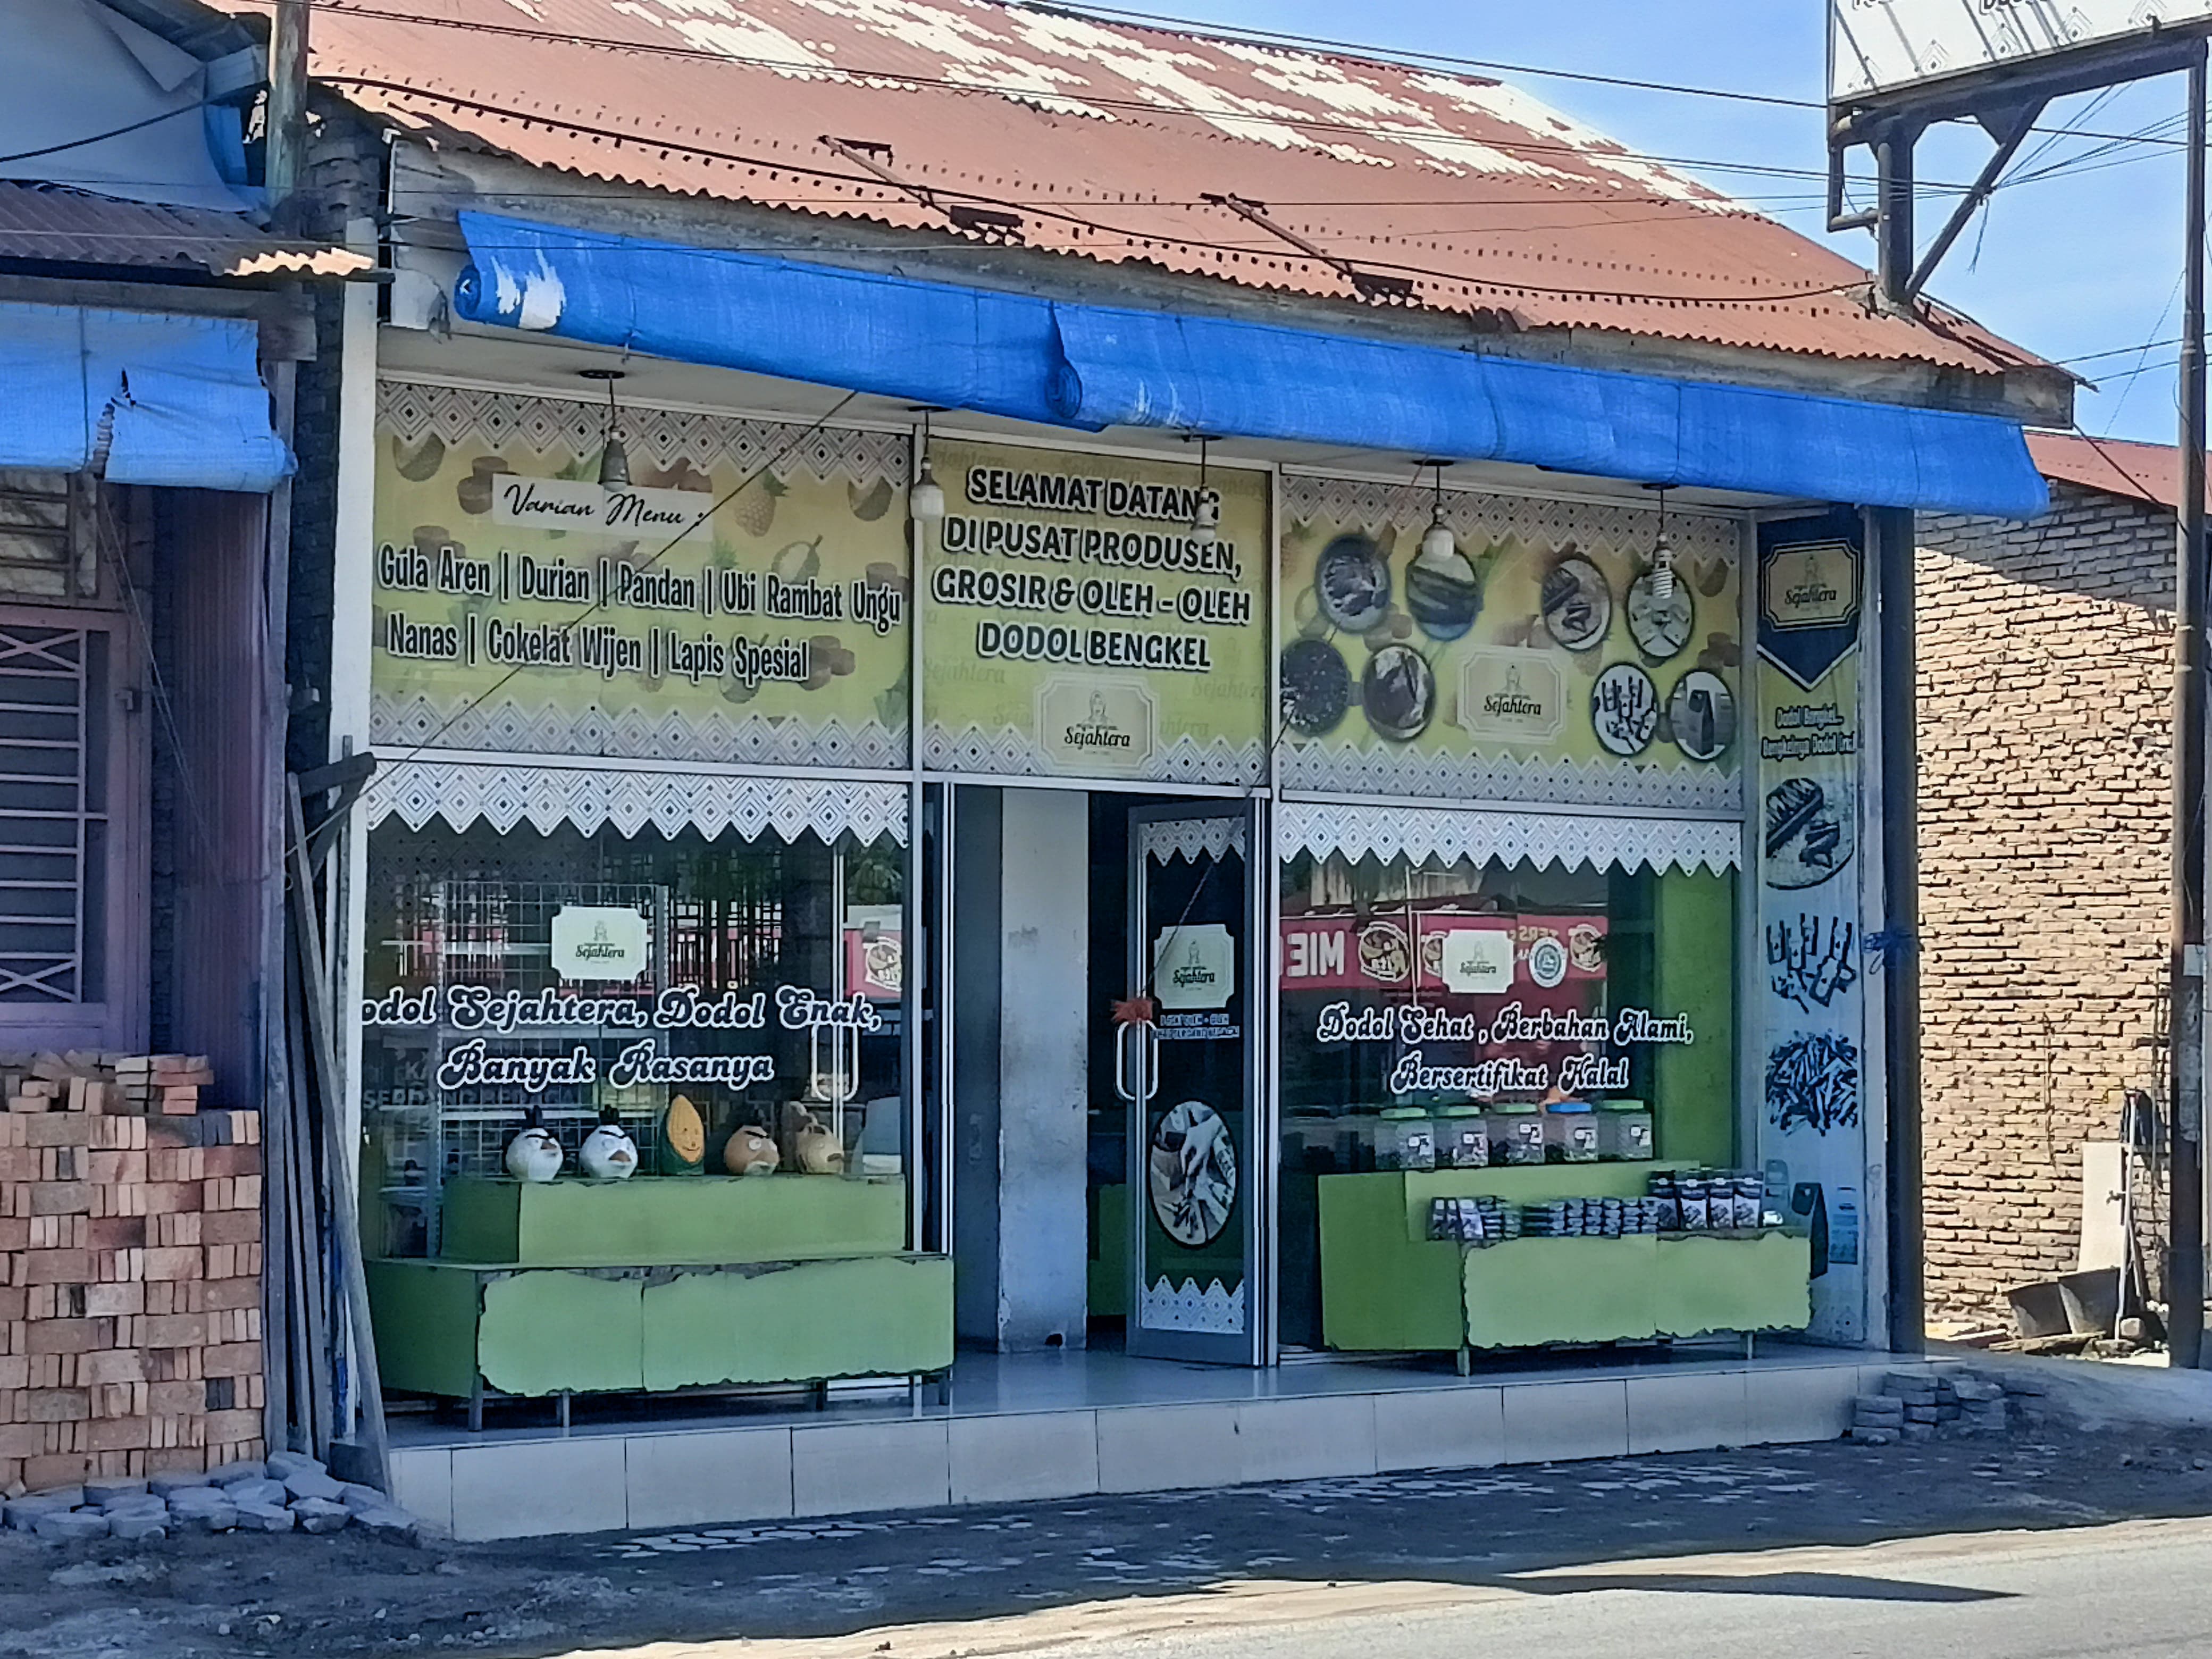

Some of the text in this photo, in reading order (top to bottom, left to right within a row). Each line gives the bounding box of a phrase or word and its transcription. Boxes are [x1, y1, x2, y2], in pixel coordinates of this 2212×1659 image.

[503, 484, 594, 518] Varian
[605, 494, 684, 526] Menu
[969, 466, 1103, 509] SELAMAT
[944, 517, 1242, 581] DI PUSAT PRODUSEN,
[380, 544, 428, 591] Gula
[439, 548, 491, 592] Aren
[521, 560, 590, 602] Durian
[619, 565, 697, 610] Pandan
[720, 569, 757, 615] Ubi
[767, 574, 843, 620] Rambat
[852, 581, 901, 636] Ungu
[934, 567, 1046, 608] GROSIR
[1051, 576, 1075, 607] &
[1080, 579, 1155, 617] OLEH
[1178, 589, 1251, 624] OLEH
[388, 613, 458, 659] Nanas
[487, 622, 572, 668] Cokelat
[581, 624, 643, 677] Wijen
[669, 634, 724, 686] Lapis
[733, 640, 808, 688] Spesial
[979, 622, 1212, 669] DODOL BENGKEL
[1065, 726, 1130, 750] Sejahtera
[362, 984, 882, 1034] odol Sejahtera, Dodol Enak,
[1317, 1002, 1394, 1042] Dodol
[1400, 1006, 1474, 1042] Sehat
[1492, 1002, 1609, 1045] Berbahan
[1614, 1008, 1694, 1046] Alami,
[437, 1039, 597, 1092] Banyak
[608, 1039, 775, 1090] Rasanya
[1390, 1050, 1629, 1095] Bersertifikat Halal
